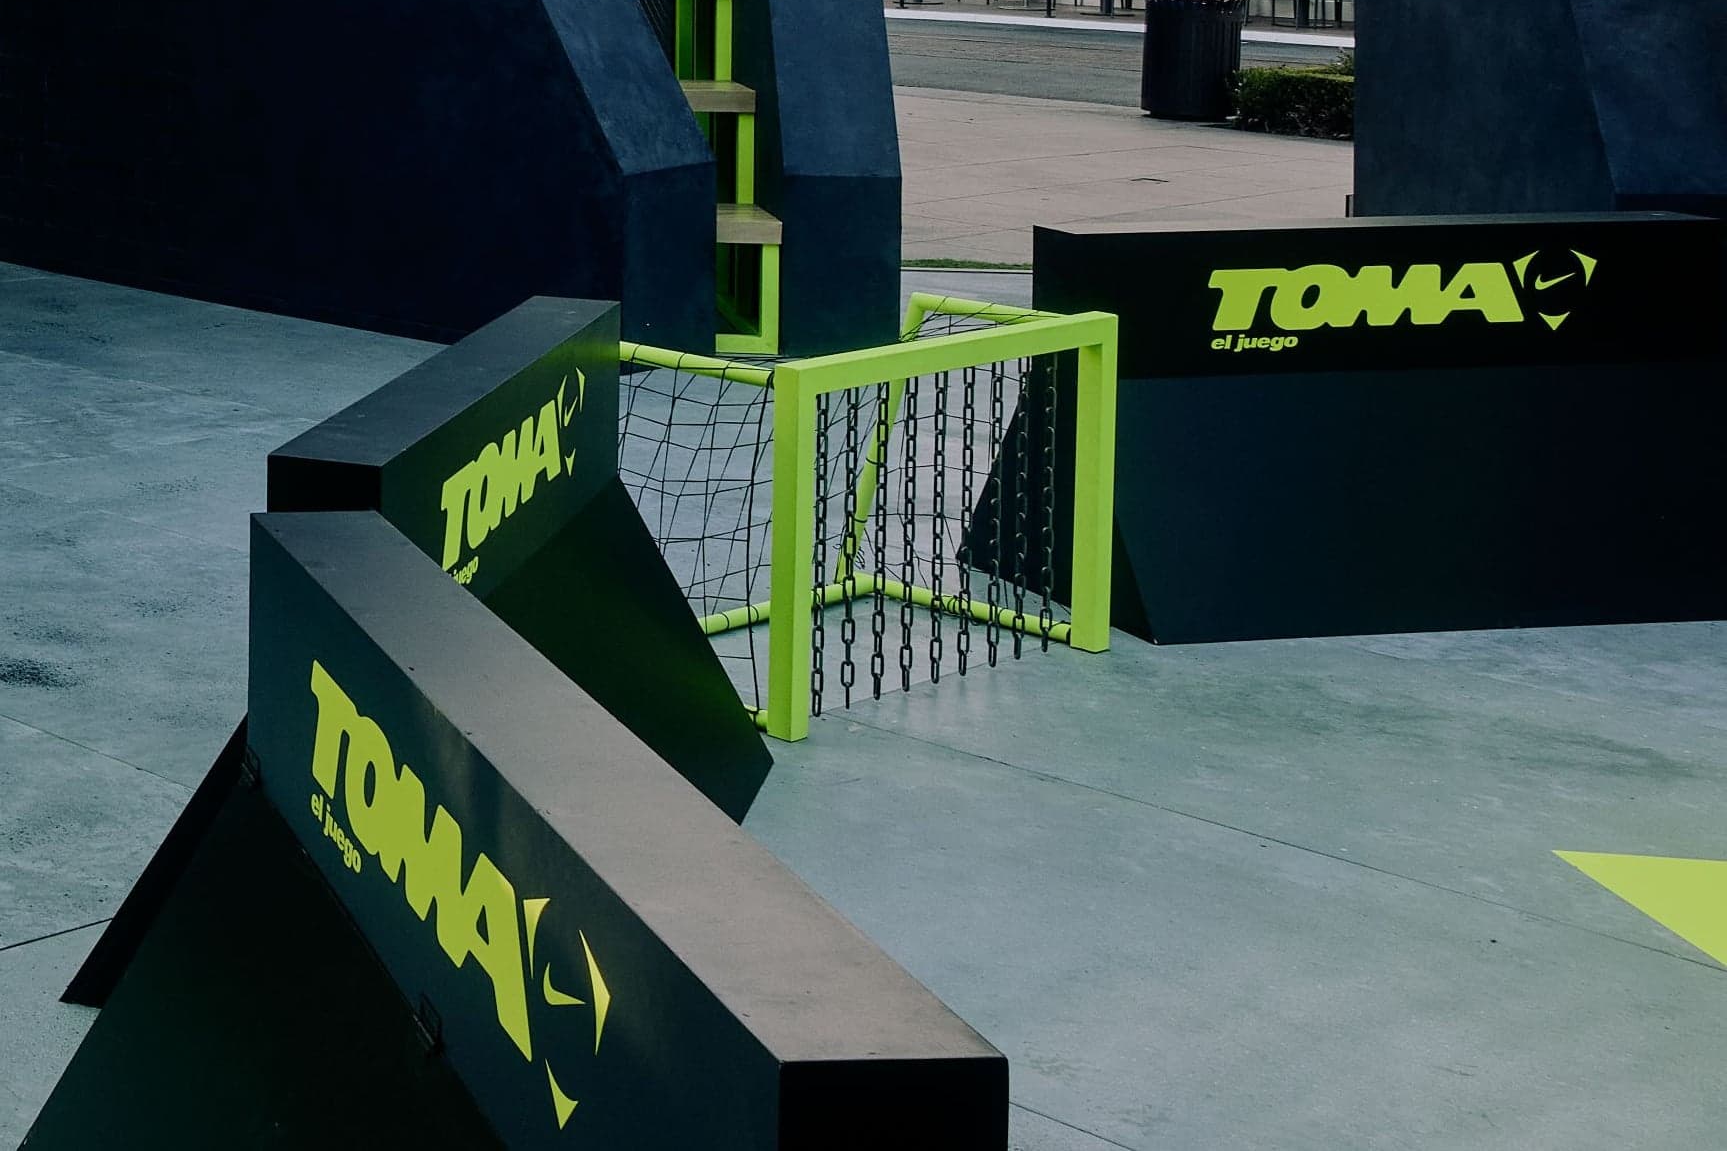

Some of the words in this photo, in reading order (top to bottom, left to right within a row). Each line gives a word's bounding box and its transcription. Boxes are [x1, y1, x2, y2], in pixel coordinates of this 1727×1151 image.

[1208, 263, 1525, 331] TOMA
[1211, 334, 1232, 350] el
[1234, 333, 1299, 352] juego
[441, 399, 562, 572] TOMA
[310, 792, 324, 824] el
[323, 797, 362, 874] juego
[310, 658, 532, 1062] TOMA
